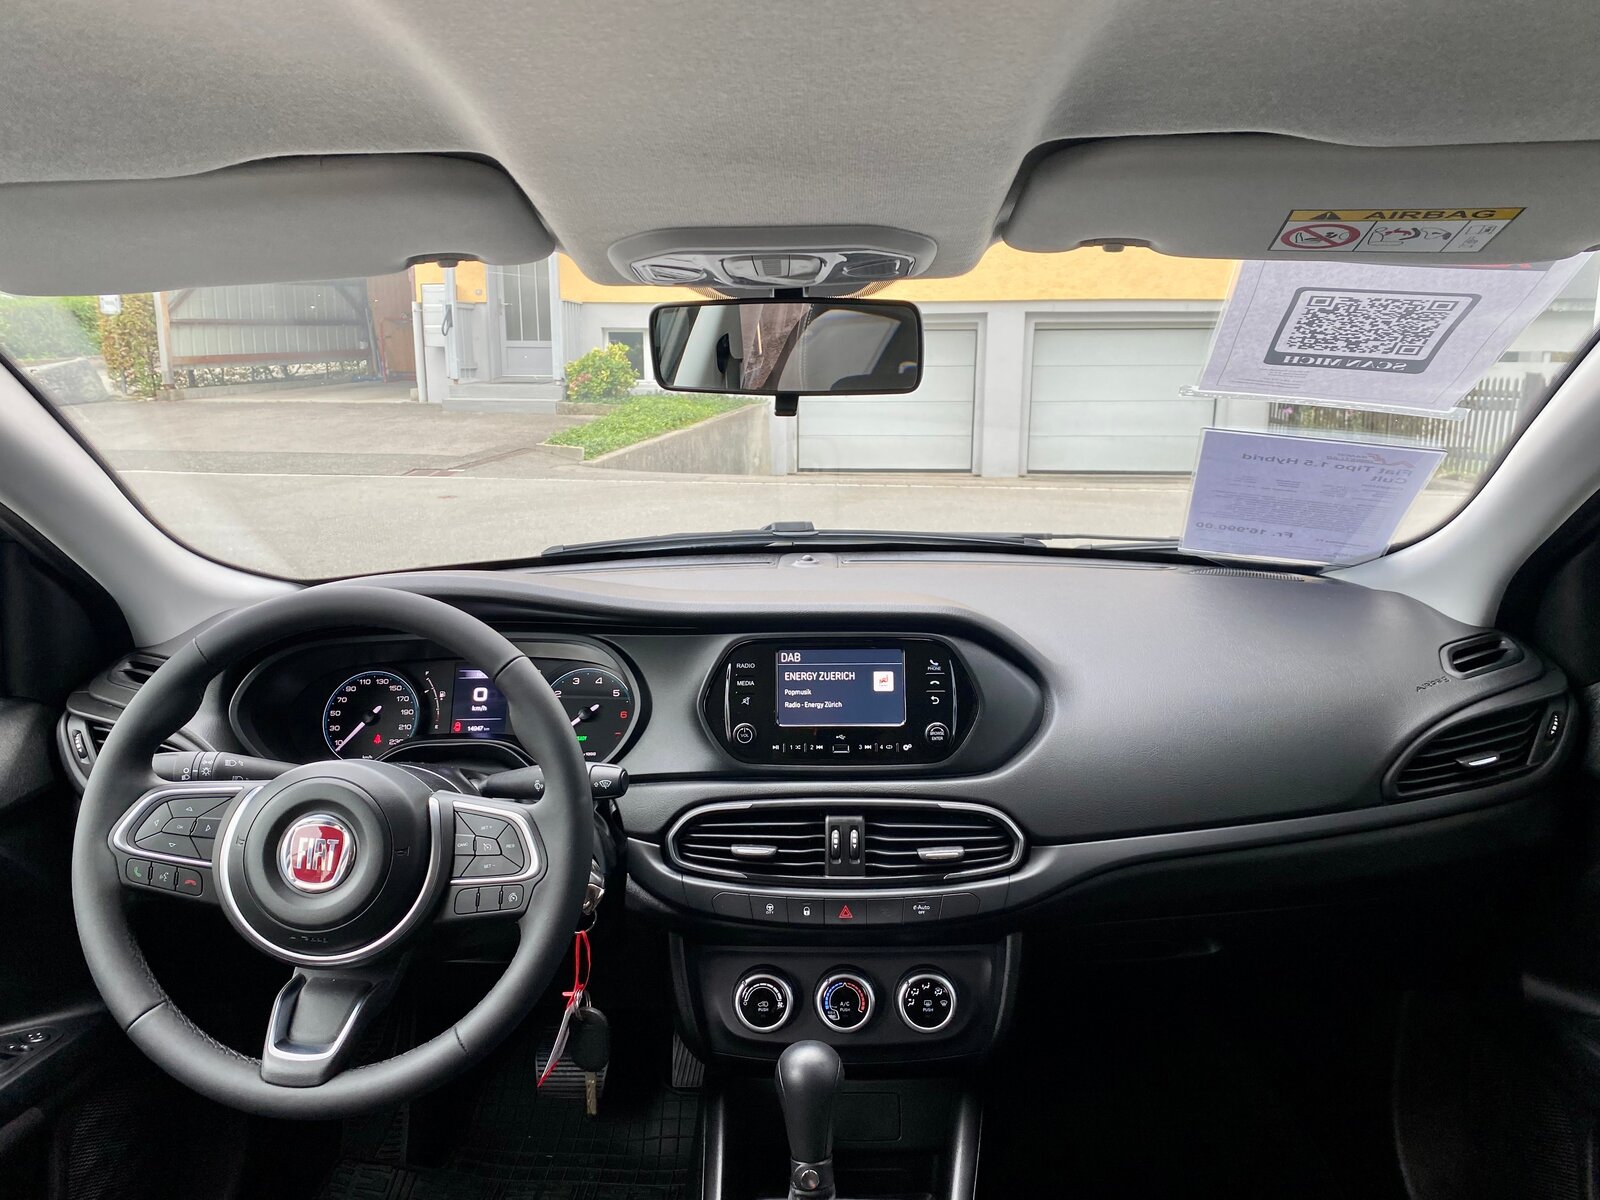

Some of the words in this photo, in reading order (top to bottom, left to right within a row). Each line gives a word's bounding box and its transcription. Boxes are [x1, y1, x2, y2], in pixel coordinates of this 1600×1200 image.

[1364, 209, 1497, 220] AIRBAG
[780, 652, 801, 662] DAB
[784, 672, 817, 681] ENERGY
[819, 672, 856, 680] ZUERICH
[473, 687, 488, 702] 0
[296, 838, 339, 871] FIAT
